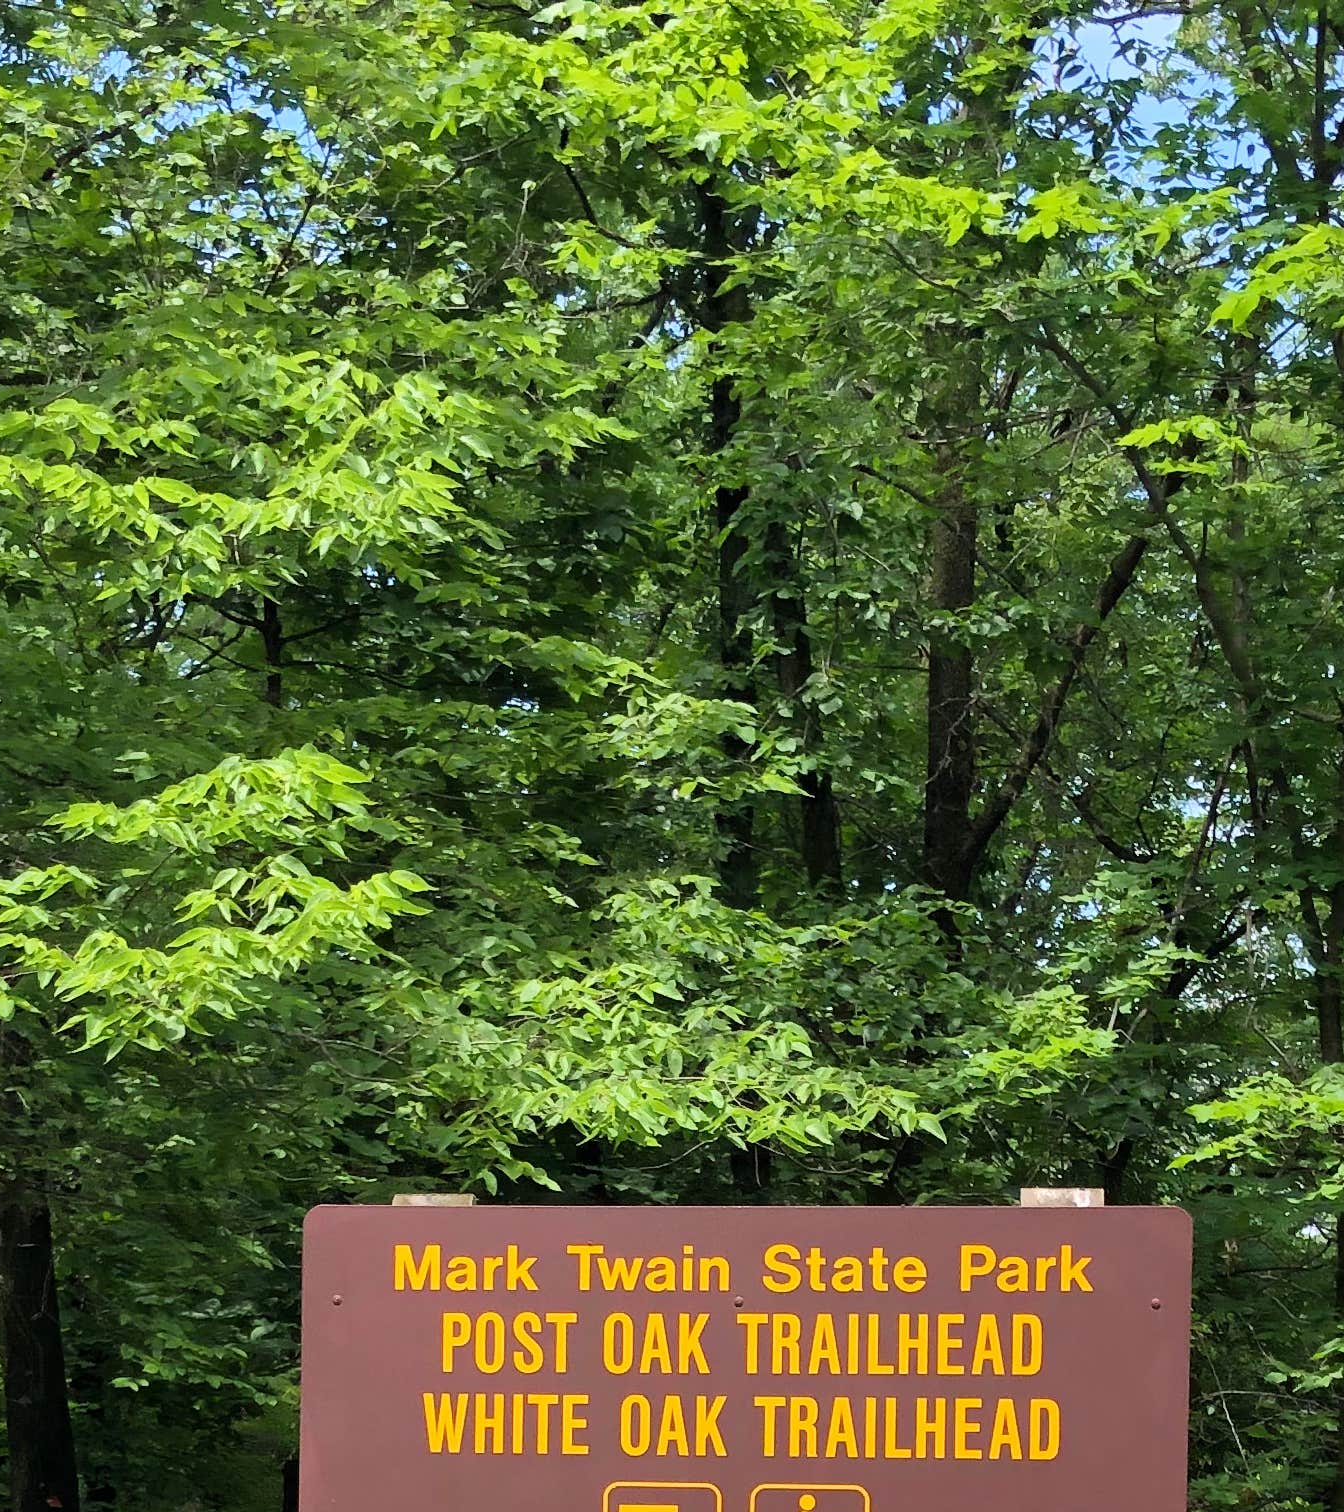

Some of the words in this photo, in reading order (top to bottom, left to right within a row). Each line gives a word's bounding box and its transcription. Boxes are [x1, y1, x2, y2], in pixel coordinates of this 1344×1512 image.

[392, 1242, 539, 1293] Mark
[564, 1242, 731, 1293] Twain
[761, 1242, 928, 1293] State
[958, 1242, 1094, 1293] Park
[440, 1310, 578, 1375] POST
[601, 1310, 711, 1375] OAK
[735, 1311, 1043, 1376] TRAILHEAD
[422, 1391, 591, 1456] WHITE
[618, 1393, 728, 1457] OAK
[752, 1394, 1061, 1461] TRAILHEAD
